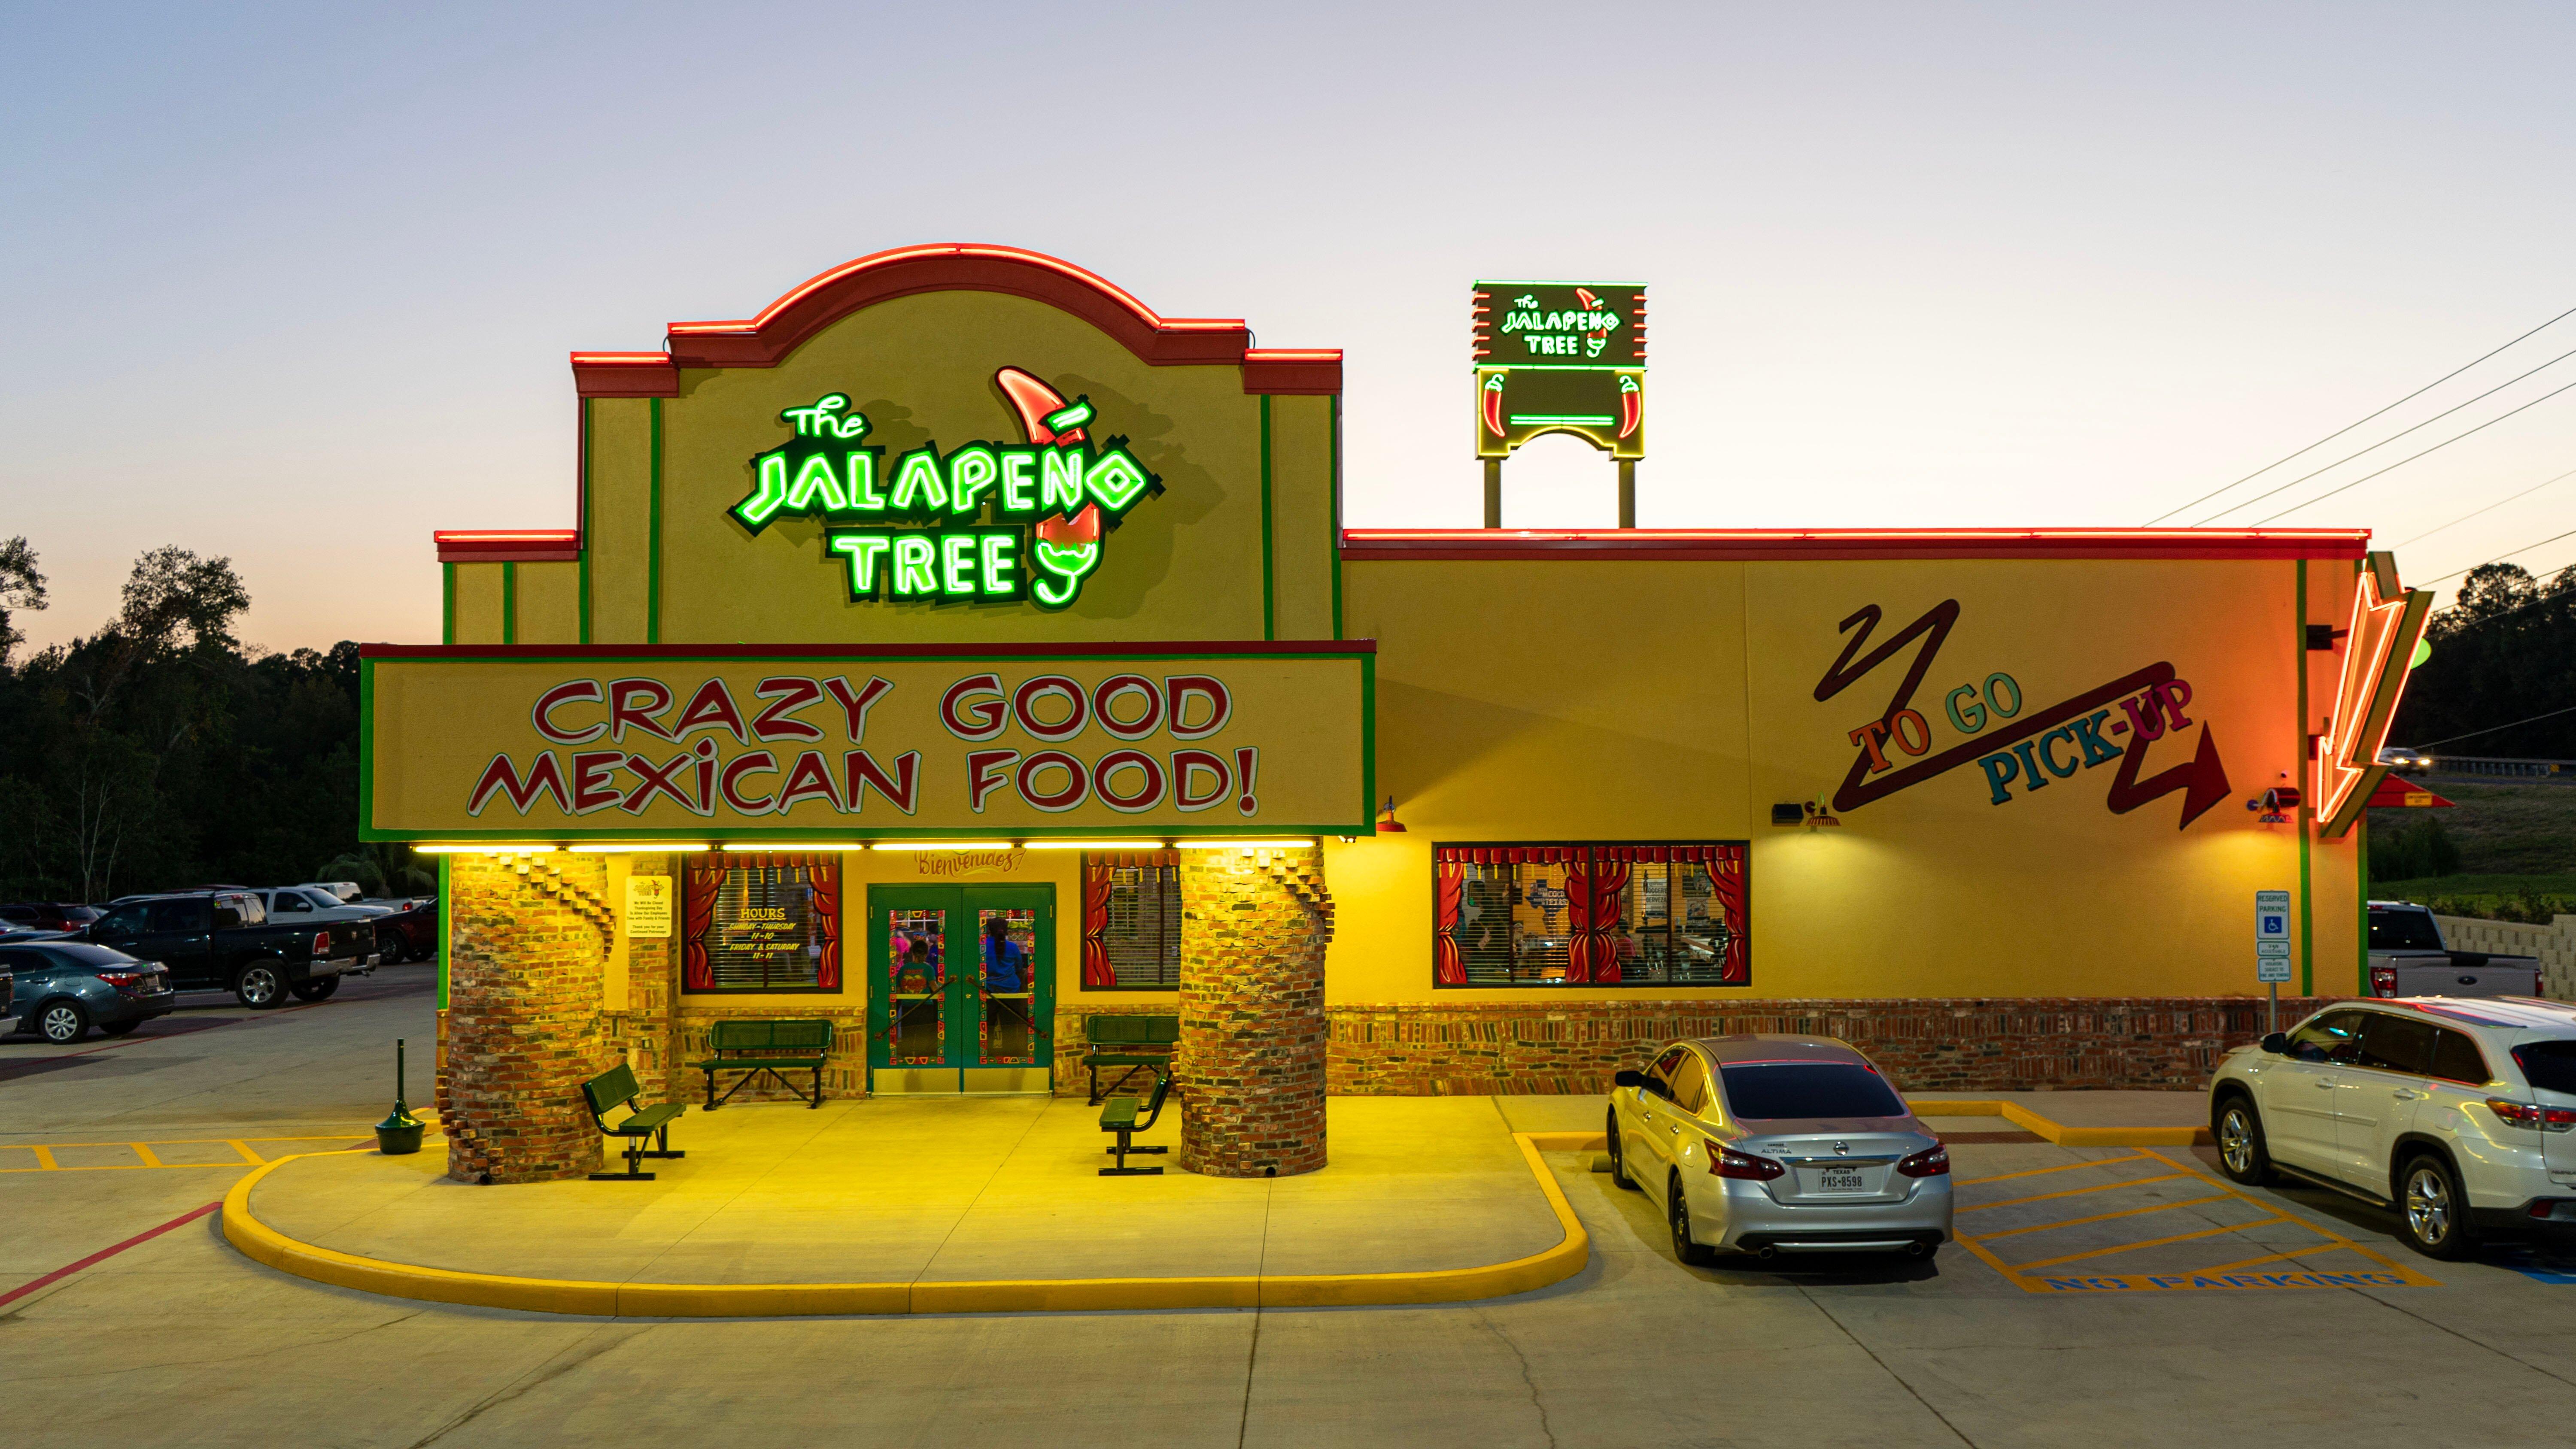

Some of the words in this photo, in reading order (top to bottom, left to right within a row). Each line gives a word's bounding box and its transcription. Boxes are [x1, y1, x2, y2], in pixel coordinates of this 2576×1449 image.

[1514, 294, 1538, 309] The
[1524, 335, 1578, 355] TREE
[784, 395, 865, 438] The
[832, 534, 1015, 595] TREE
[531, 676, 894, 746] CRAZY
[939, 673, 1232, 743] GOOD
[1849, 709, 1931, 773] TO
[1945, 672, 2022, 734] GO
[1978, 679, 2193, 805] PICK-UP
[966, 746, 1259, 818] FOOD!
[741, 908, 785, 918] HOURS
[2042, 1277, 2130, 1290] NO
[2148, 1273, 2406, 1288] PARKING
